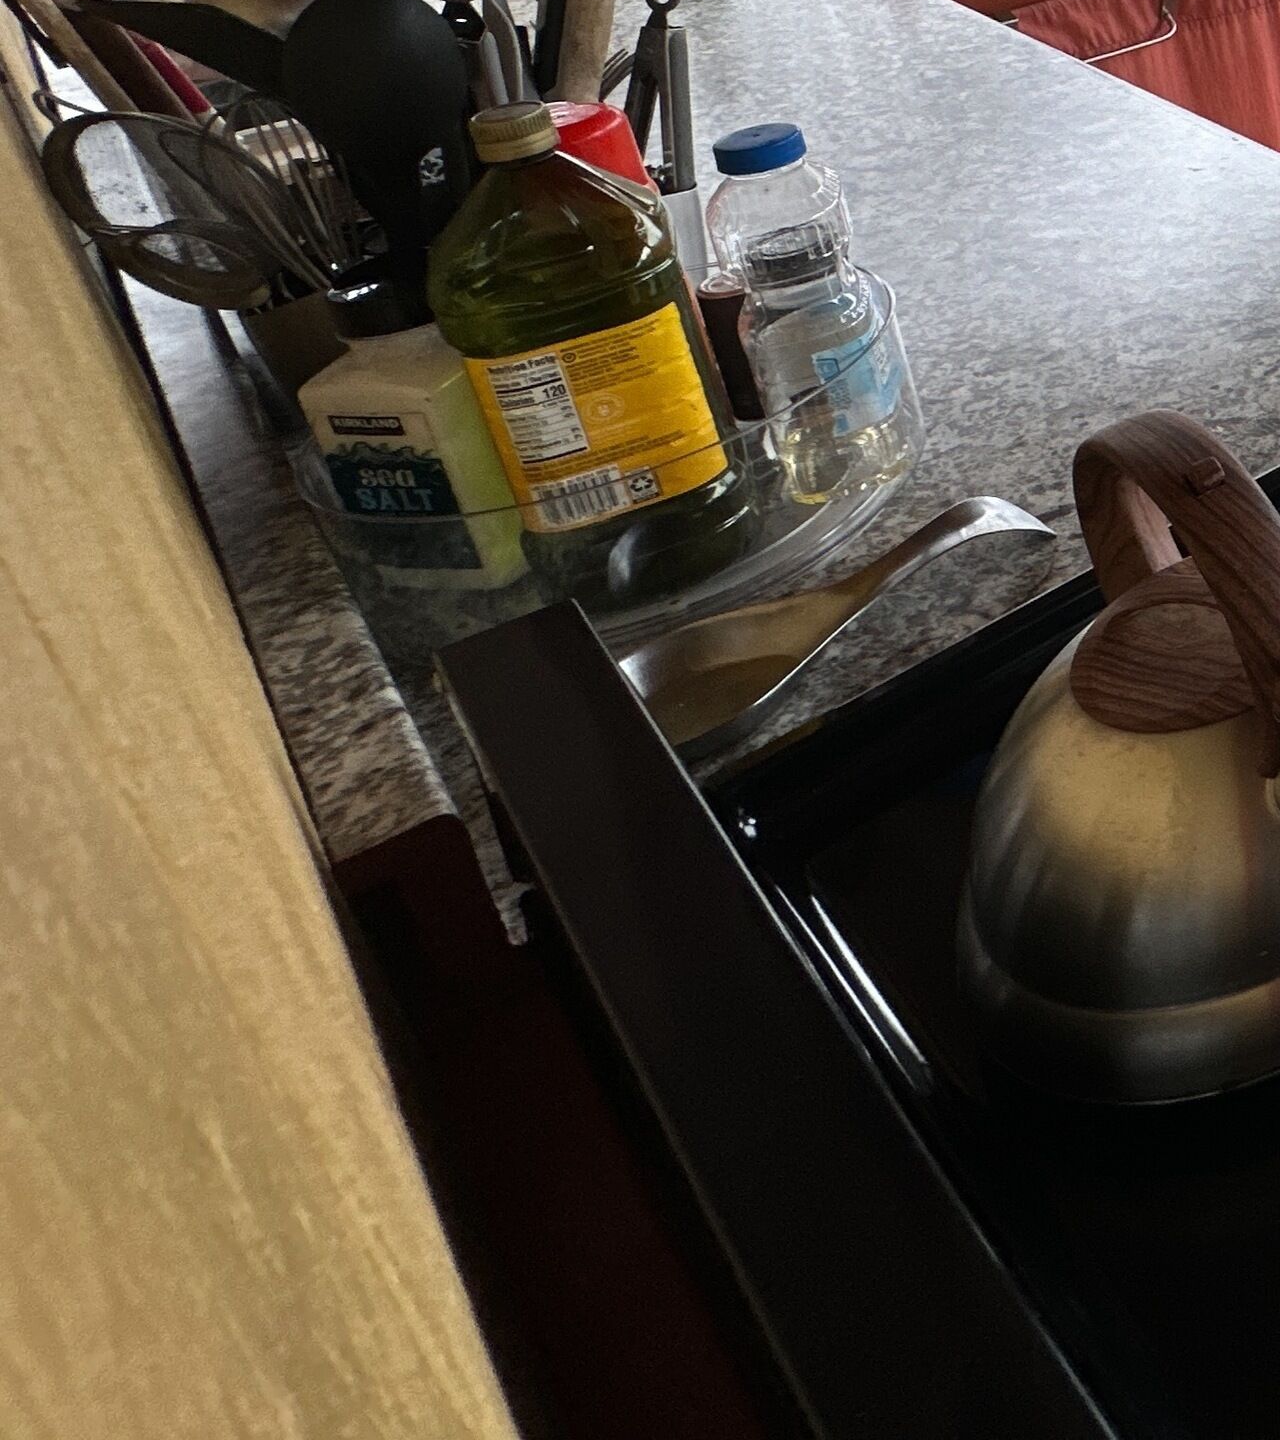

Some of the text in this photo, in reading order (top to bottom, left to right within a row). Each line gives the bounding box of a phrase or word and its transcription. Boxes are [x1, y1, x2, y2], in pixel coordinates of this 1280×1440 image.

[542, 383, 567, 399] 120
[358, 468, 417, 488] sea
[355, 487, 434, 511] SALT
